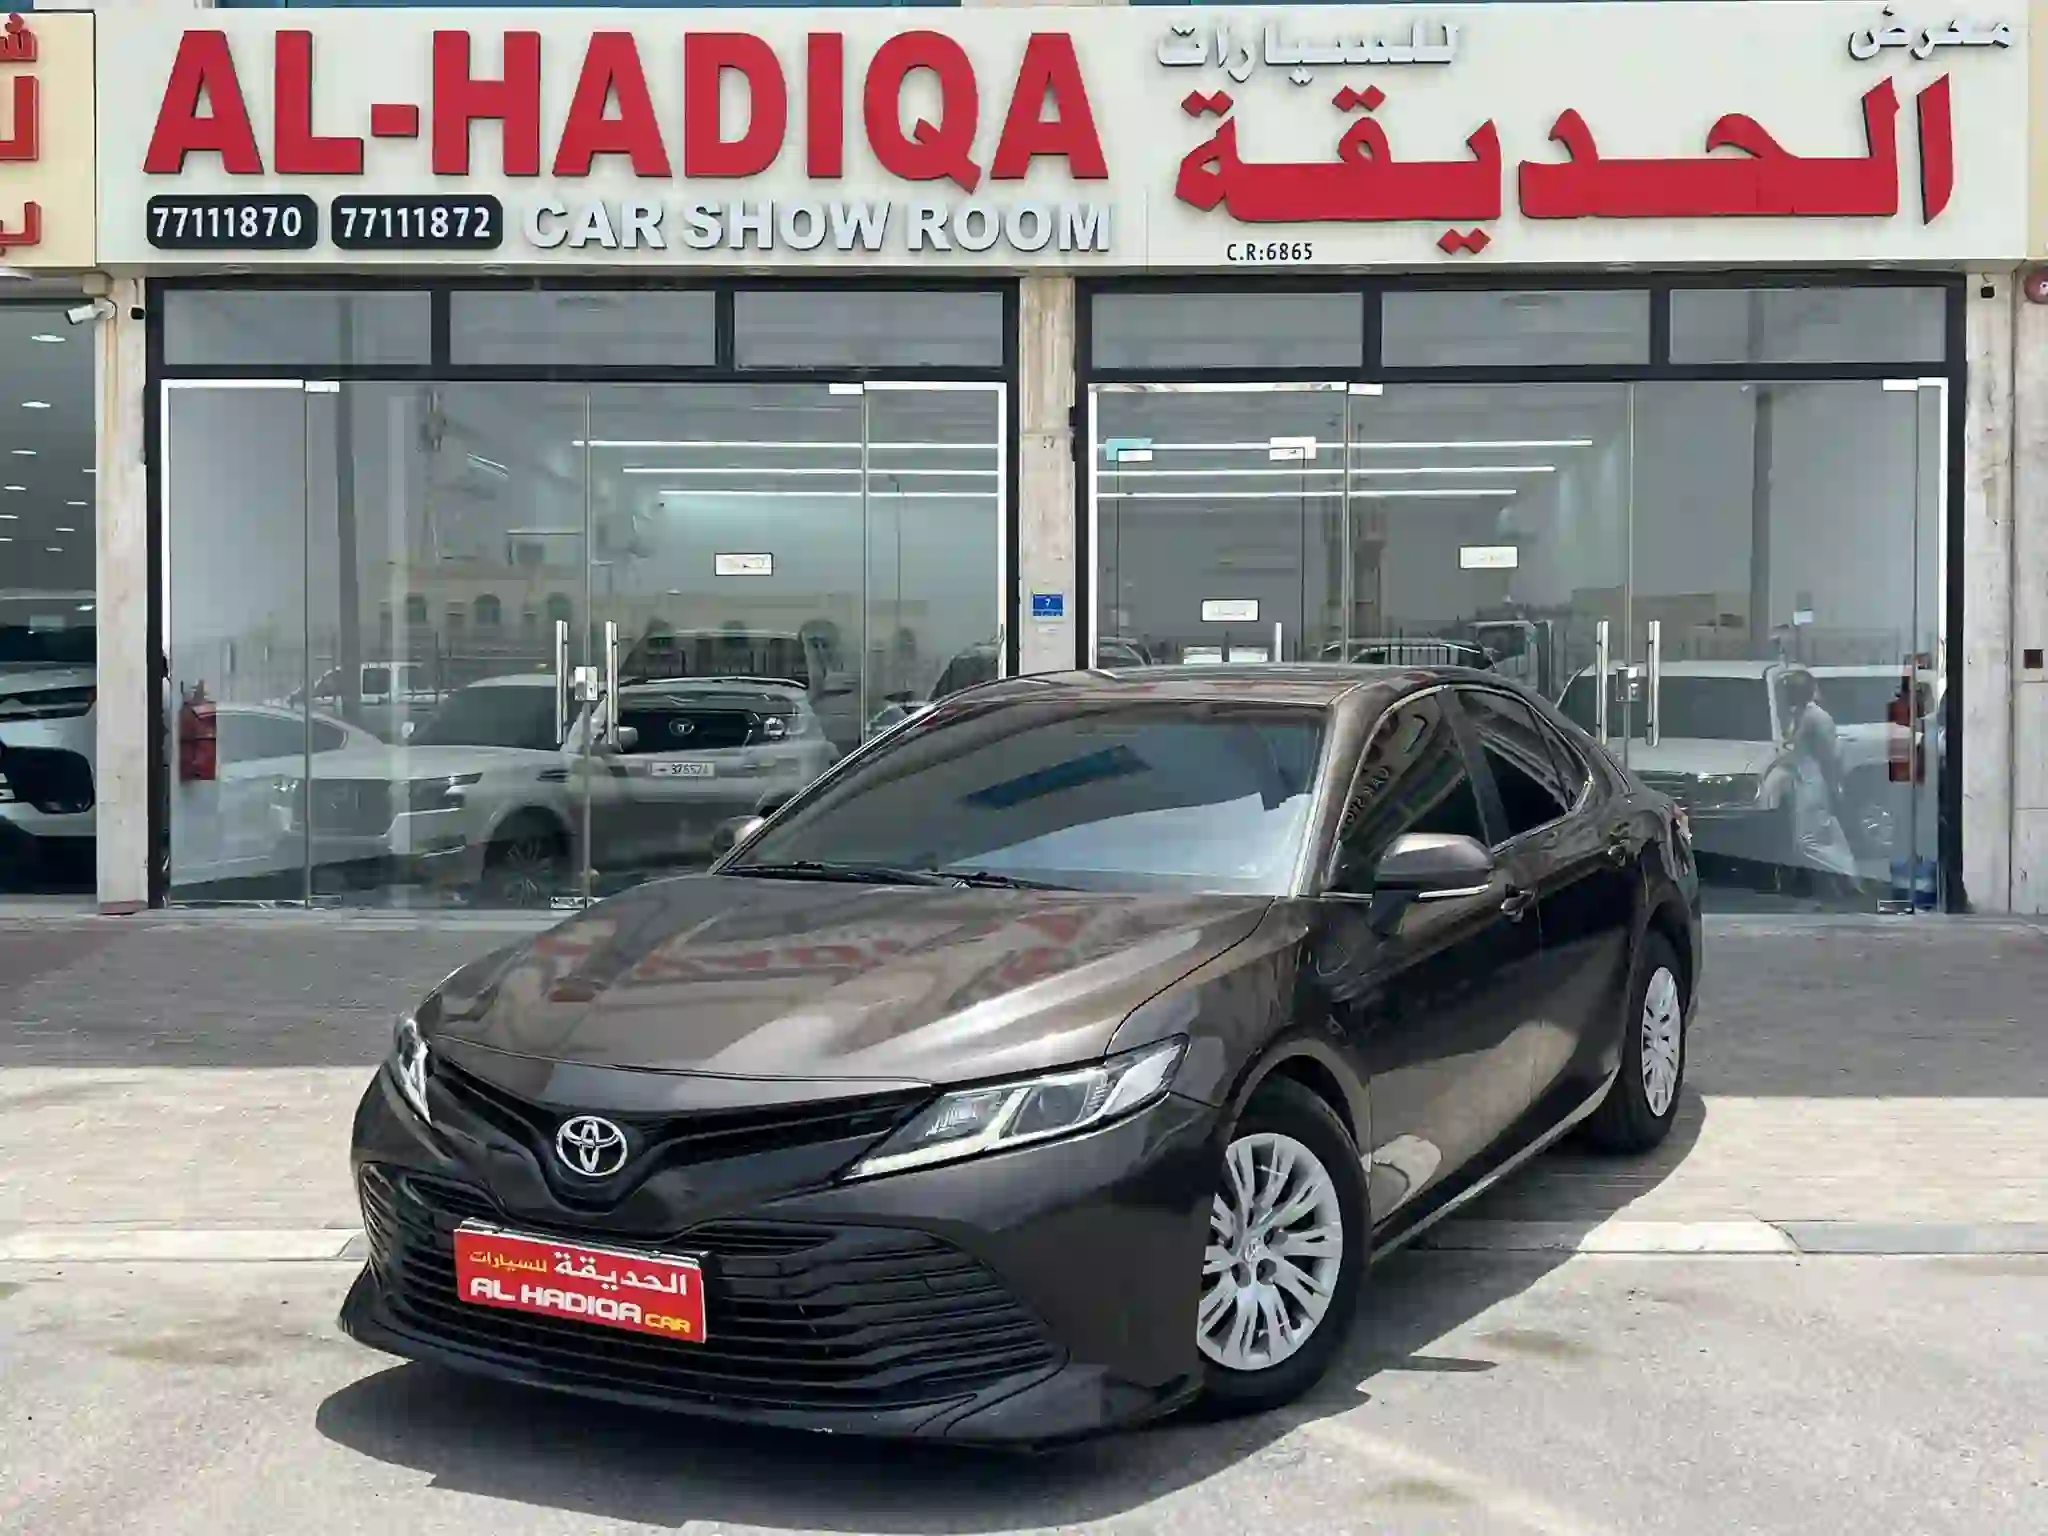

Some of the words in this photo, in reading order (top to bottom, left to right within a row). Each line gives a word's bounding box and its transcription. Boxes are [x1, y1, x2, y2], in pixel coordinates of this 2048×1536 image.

[1157, 20, 1458, 85] للسيارات
[1848, 4, 2011, 60] معرض
[143, 29, 1109, 194] AL-HADIQA
[1174, 72, 1955, 255] الحديقة
[152, 206, 302, 238] 77111870
[340, 207, 491, 238] 77111872
[523, 199, 667, 250] CAR
[684, 200, 890, 251] SHOW
[908, 202, 1110, 252] ROOM
[1227, 242, 1313, 261] C.R:6865
[469, 1250, 548, 1274] للسيارات
[553, 1250, 687, 1296] الحديقة
[470, 1277, 516, 1302] AL
[644, 1312, 691, 1333] CAR
